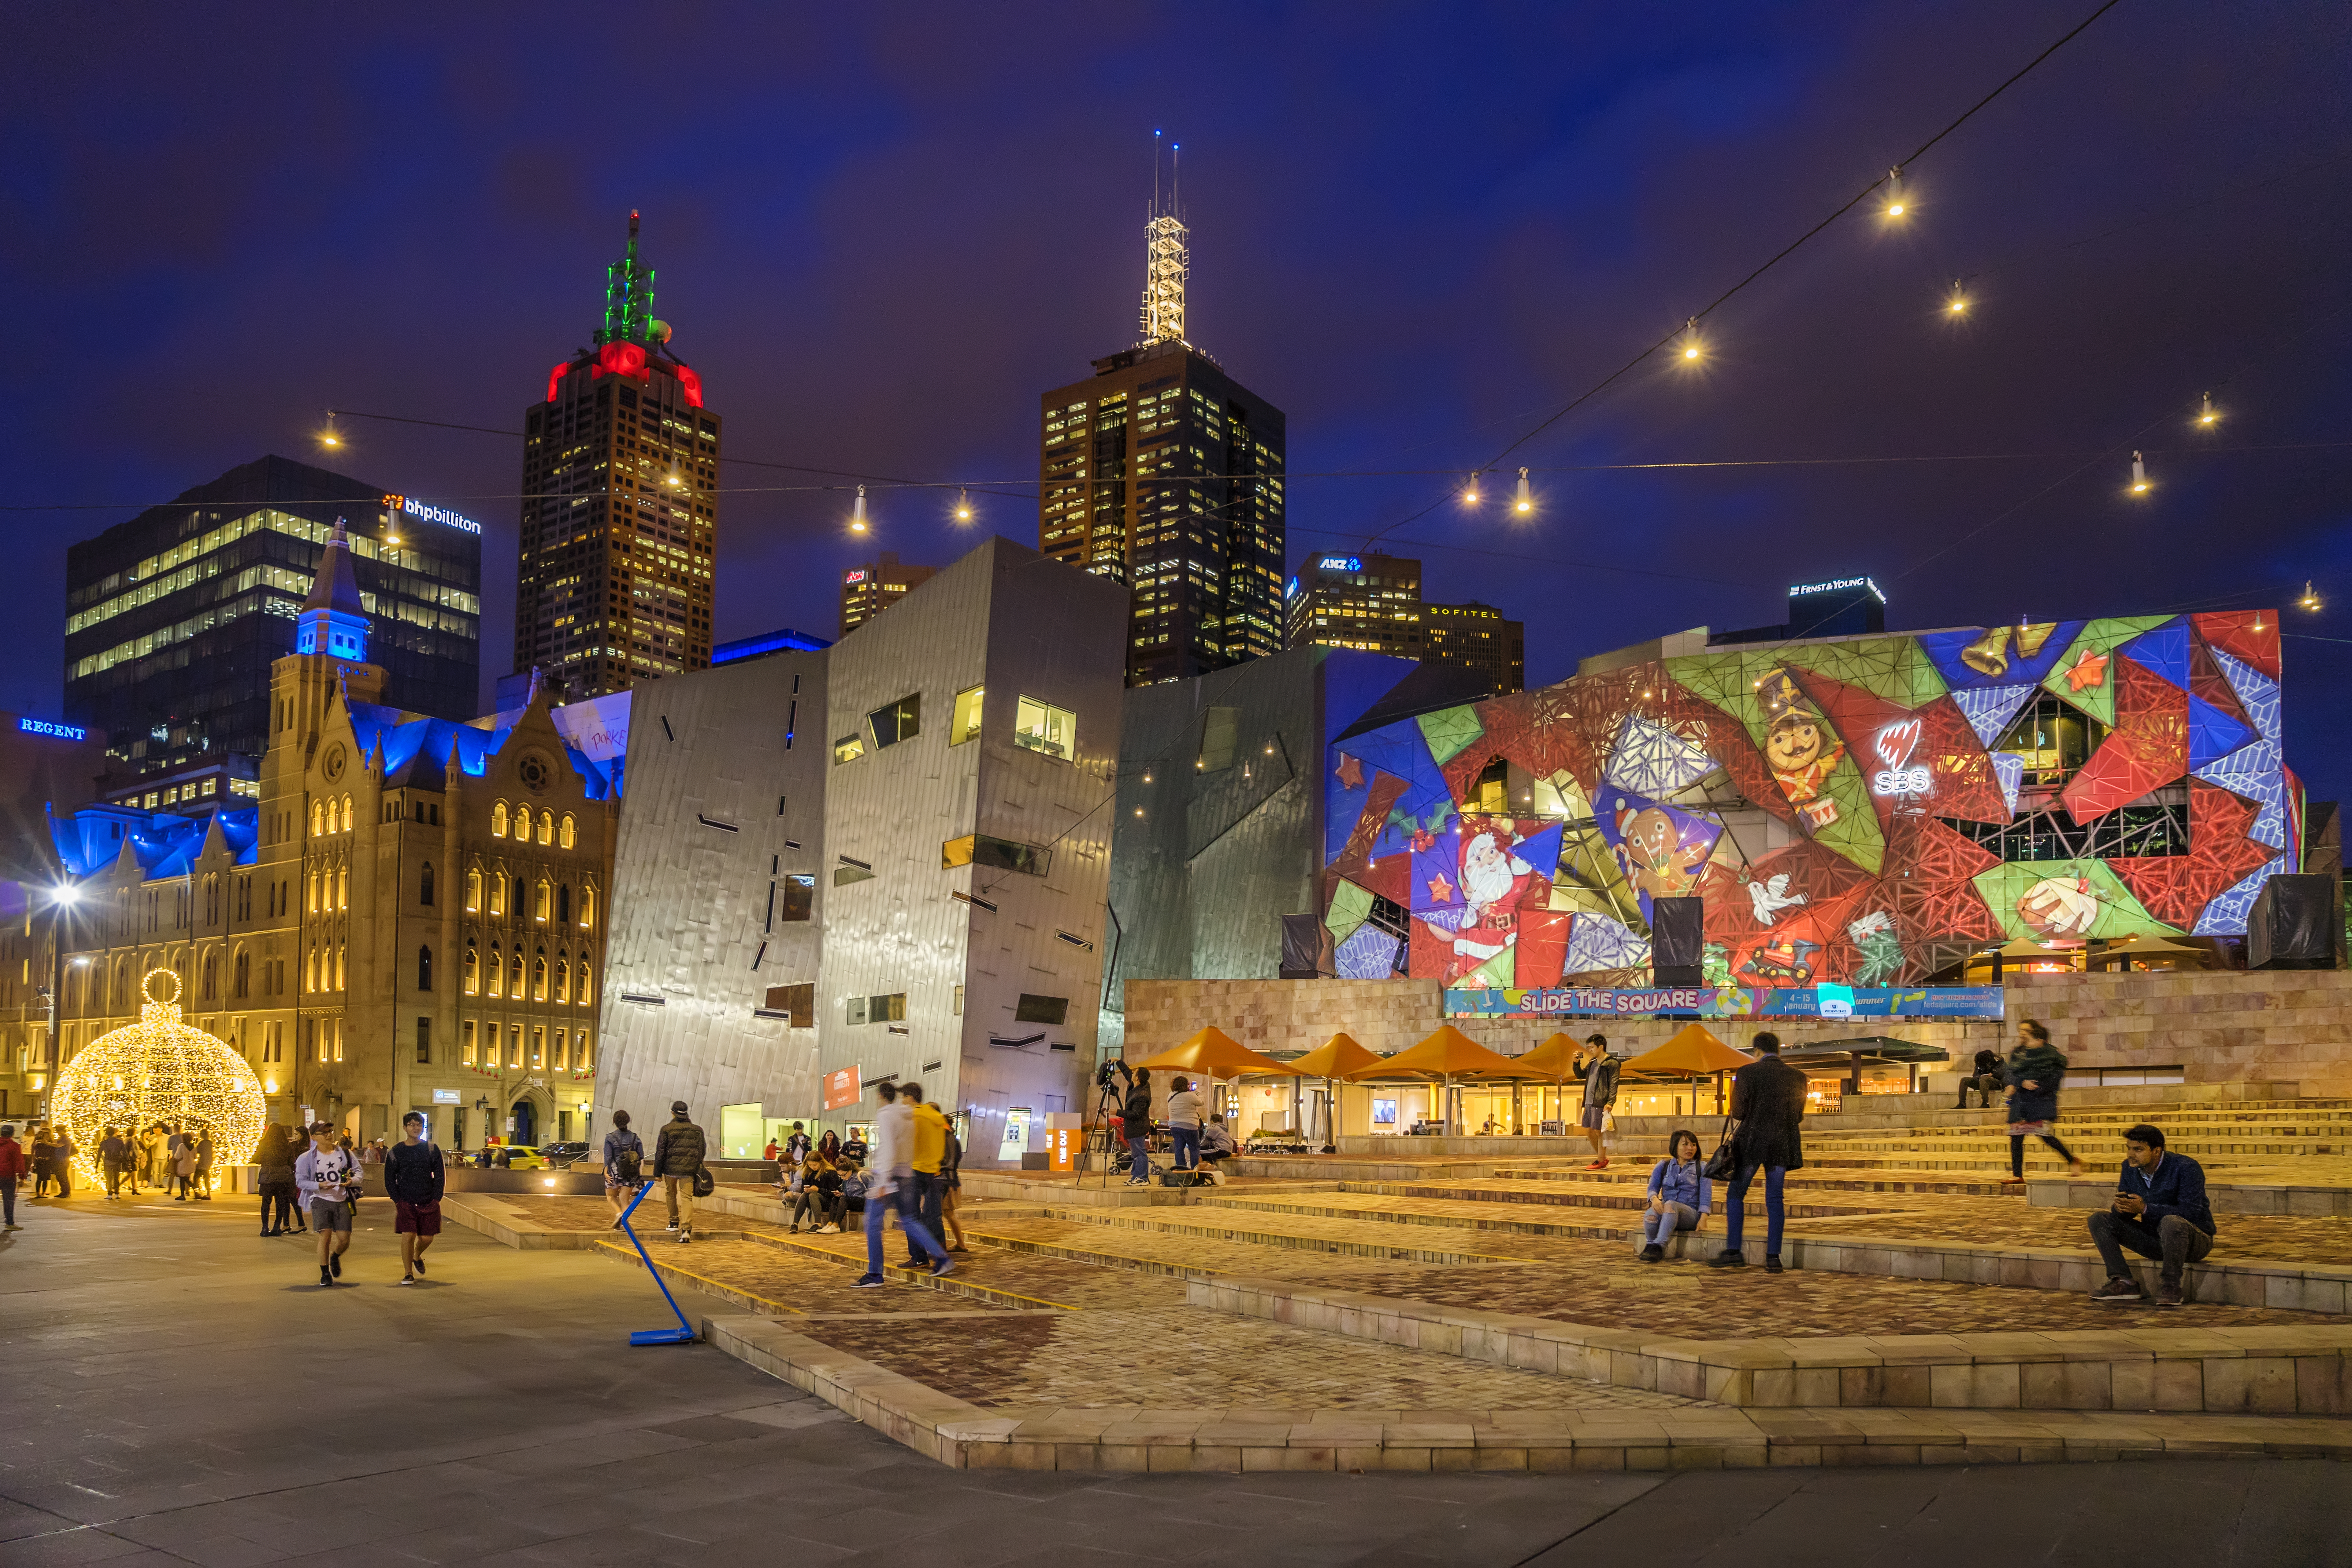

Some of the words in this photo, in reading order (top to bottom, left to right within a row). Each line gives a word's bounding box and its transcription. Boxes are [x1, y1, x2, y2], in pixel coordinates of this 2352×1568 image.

[405, 497, 481, 534] bhpbilliton
[1320, 558, 1347, 570] ANZ
[1833, 577, 1864, 589] YOUNG
[1431, 608, 1498, 619] SOFITEL
[21, 719, 85, 740] REGENT
[1876, 769, 1928, 793] SBS
[1576, 991, 1612, 1009] THE
[1617, 991, 1698, 1011] SQUARE
[1855, 995, 1886, 1005] ummer
[316, 1170, 343, 1182] BO
